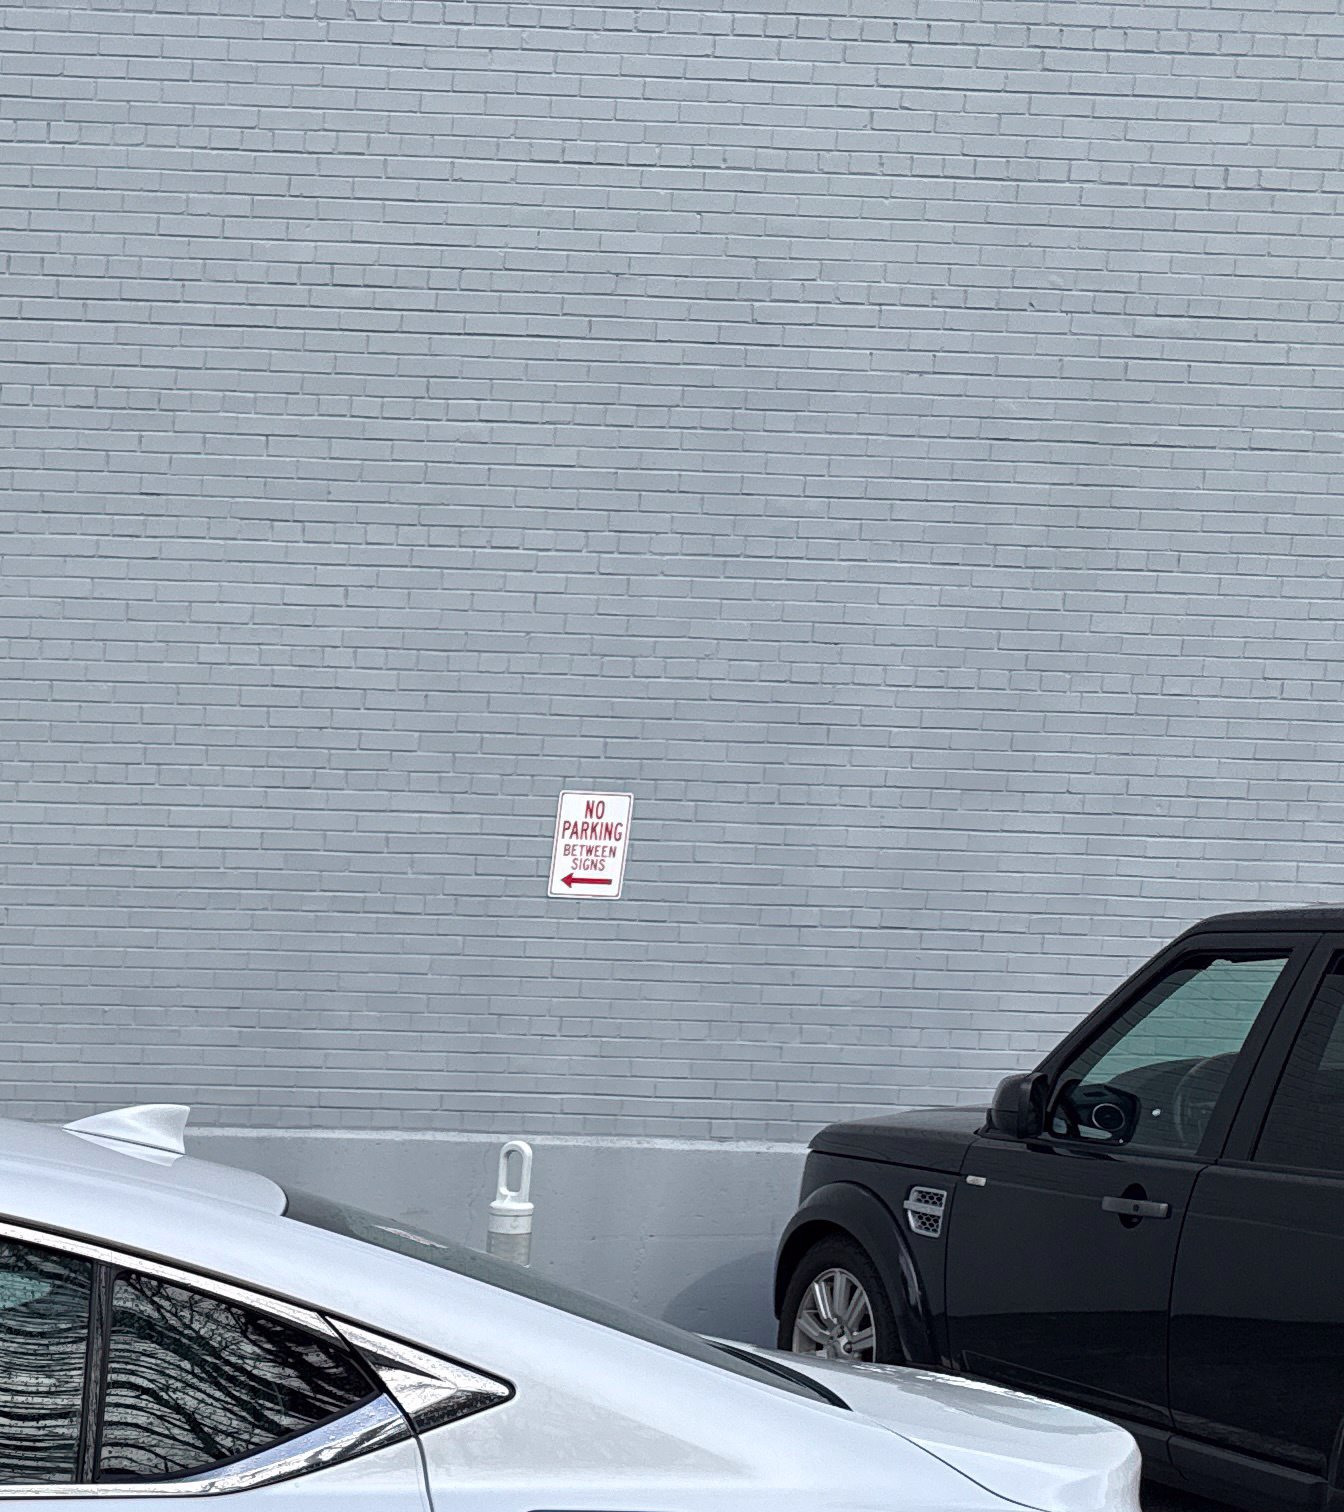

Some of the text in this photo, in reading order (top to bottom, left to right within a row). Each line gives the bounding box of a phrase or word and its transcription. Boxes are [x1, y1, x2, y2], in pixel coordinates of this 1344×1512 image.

[584, 800, 605, 820] NO
[561, 820, 624, 842] PARKING
[563, 844, 617, 858] BETWEEN
[571, 858, 606, 871] SIGNS
